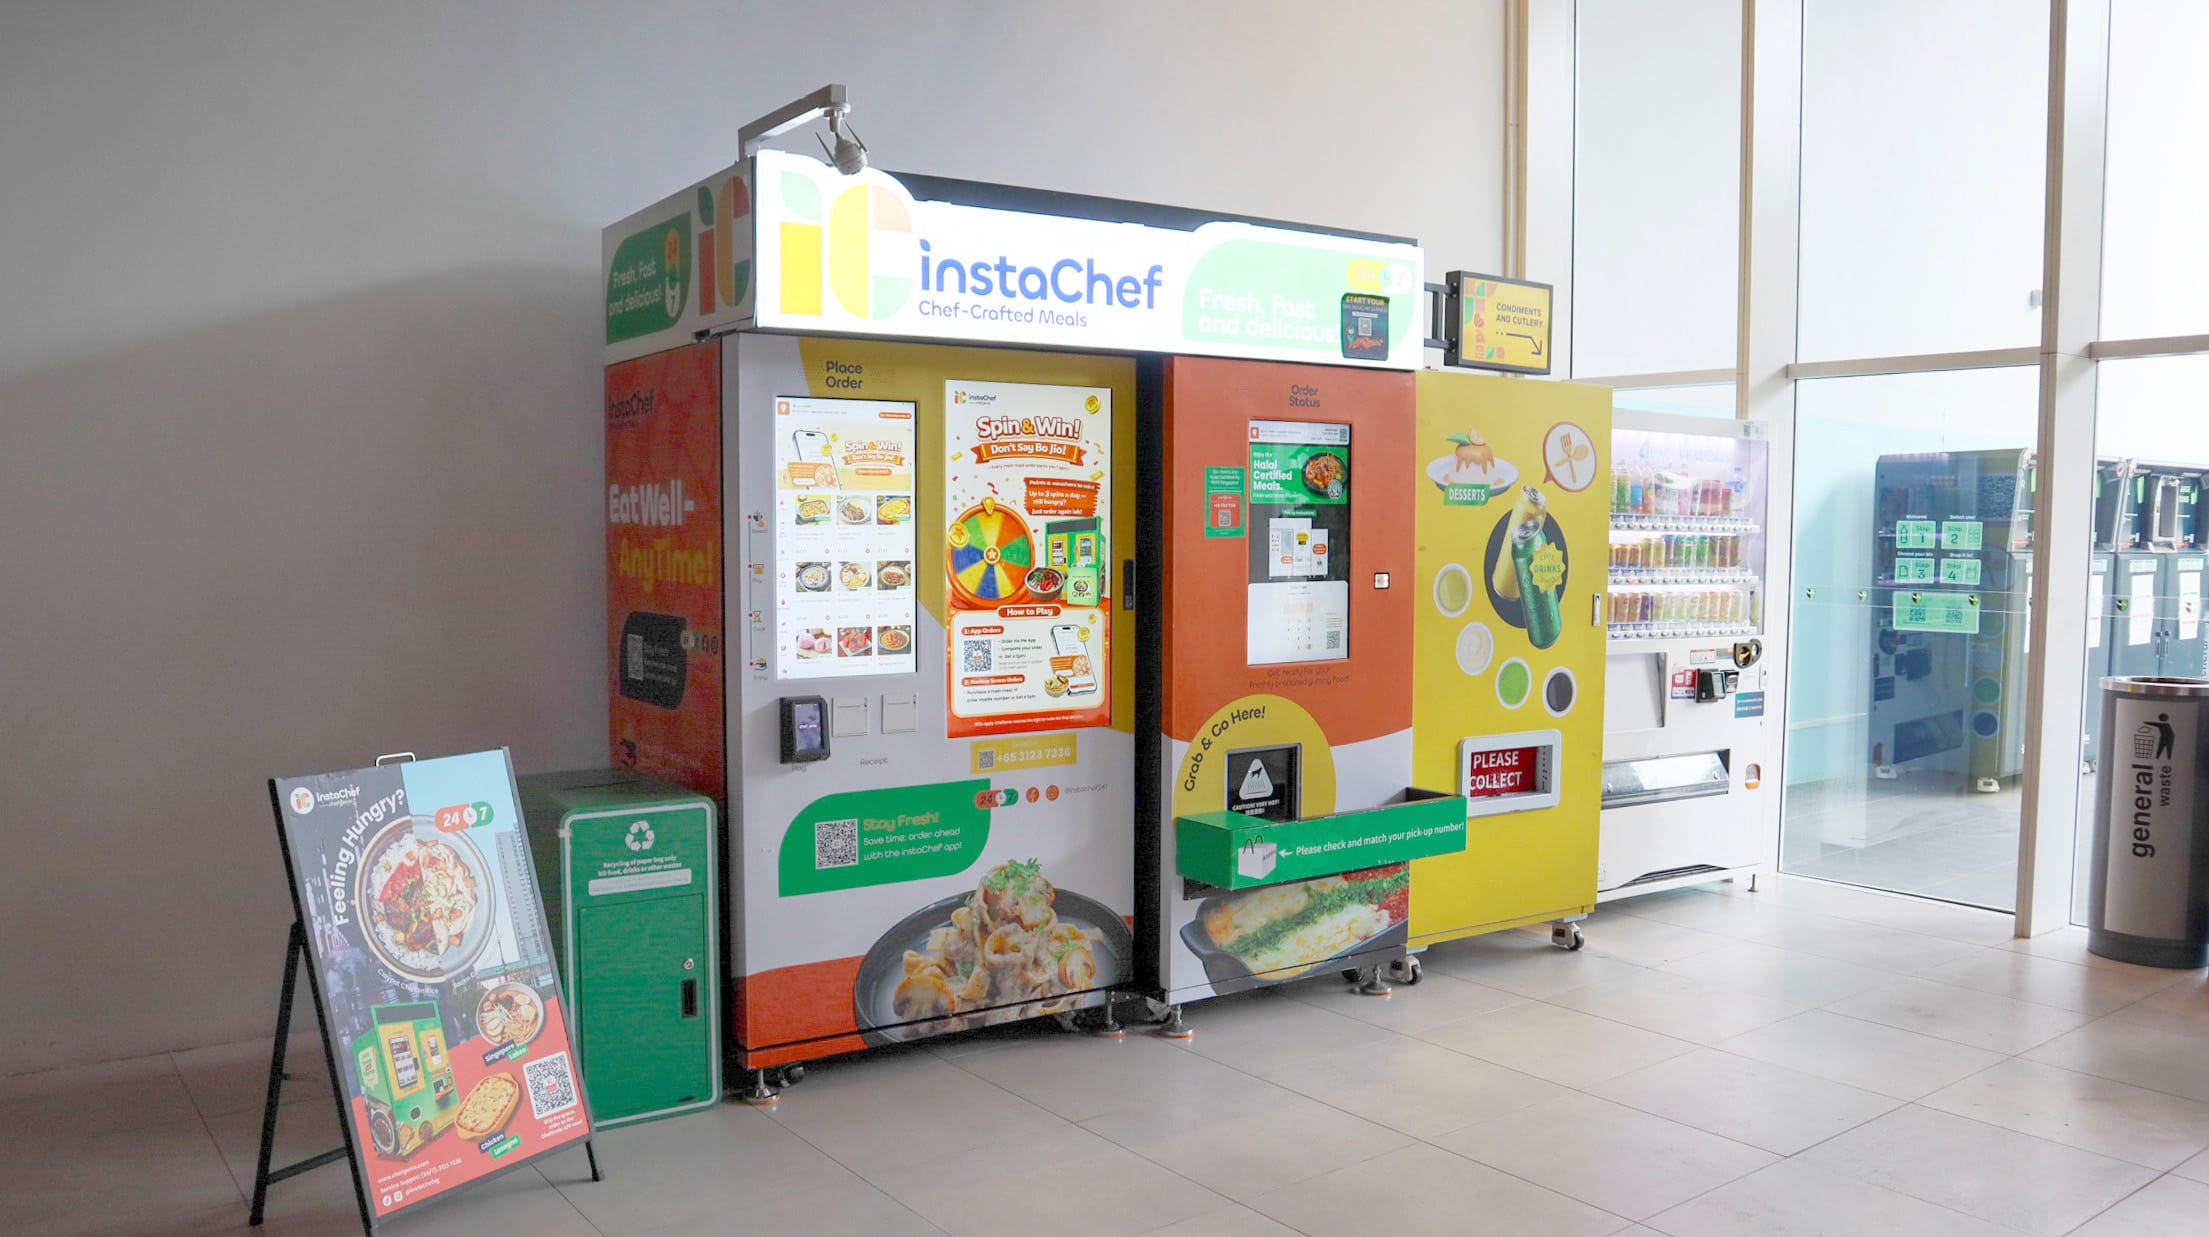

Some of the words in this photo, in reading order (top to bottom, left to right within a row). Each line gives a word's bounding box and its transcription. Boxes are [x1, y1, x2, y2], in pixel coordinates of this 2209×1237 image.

[613, 266, 637, 289] Fresh,
[919, 238, 1162, 310] instaChef
[609, 299, 624, 317] and
[1199, 289, 1265, 318] Fresh,
[1271, 295, 1317, 320] Fast
[1367, 297, 1386, 306] YOUR
[919, 300, 1034, 323] Chef-Crafted
[1038, 310, 1087, 328] Meals
[1496, 303, 1542, 317] CONDIMENTS
[1199, 315, 1241, 335] and
[1496, 314, 1511, 324] AND
[1512, 316, 1544, 329] CUTLERY
[825, 360, 863, 374] Place
[825, 376, 863, 389] Order
[968, 392, 997, 402] instaChef
[1291, 384, 1319, 396] Order
[1289, 396, 1321, 408] Status
[976, 415, 1021, 440] Spin
[1021, 417, 1035, 434] &
[1034, 416, 1082, 440] Win!
[844, 440, 870, 454] Spin
[875, 440, 903, 452] Win!
[990, 443, 1016, 454] Don't
[1017, 443, 1035, 455] Say
[1035, 443, 1048, 453] Bo
[1049, 444, 1066, 456] Jio!
[1253, 459, 1278, 470] Halal
[1253, 470, 1293, 481] Certified
[1253, 481, 1284, 491] Meals.
[1050, 491, 1065, 499] spins
[1448, 487, 1486, 501] DESSERTS
[1044, 498, 1067, 506] hungry?
[1915, 525, 1931, 534] Step
[1947, 526, 1963, 534] Step
[1951, 533, 1959, 545] 2
[1534, 564, 1562, 573] DRINKS
[1914, 562, 1930, 570] Step
[1946, 563, 1962, 571] Step
[1918, 569, 1926, 580] 3
[1948, 571, 1956, 580] 4
[1006, 608, 1025, 616] How
[1025, 607, 1035, 615] to
[1035, 607, 1054, 617] Play
[970, 628, 982, 636] App
[1184, 751, 1204, 792] Grab
[1200, 737, 1214, 751] &
[1211, 718, 1230, 738] Go
[1231, 705, 1267, 726] Here!
[859, 757, 889, 768] Receipt
[997, 751, 1017, 764] +65
[1019, 750, 1043, 763] 3123
[1473, 751, 1520, 769] PLEASE
[1470, 771, 1523, 791] COLLECT
[2160, 765, 2172, 807] waste
[316, 786, 361, 803] instaChef
[443, 811, 460, 828] 24
[479, 806, 488, 821] 7
[2131, 763, 2156, 858] general
[342, 788, 405, 849] Hungry?
[862, 817, 896, 833] Stay
[897, 812, 940, 829] Fresh!
[863, 836, 885, 847] Save
[908, 830, 932, 841] order
[934, 826, 961, 838] ahead
[1296, 845, 1323, 857] Please
[1323, 838, 1347, 852] check
[1347, 836, 1363, 849] and
[1363, 833, 1387, 846] match
[1388, 831, 1406, 845] your
[1406, 827, 1434, 841] pick-up
[1434, 821, 1465, 836] number!
[863, 850, 884, 861] with
[884, 848, 900, 859] the
[943, 841, 963, 853] app!
[603, 860, 630, 870] Recycling
[630, 858, 637, 866] of
[636, 858, 653, 867] paper
[653, 856, 664, 864] bag
[329, 850, 356, 927] Feeling
[484, 1043, 515, 1063] Singapore
[480, 1133, 505, 1151] Chicken
